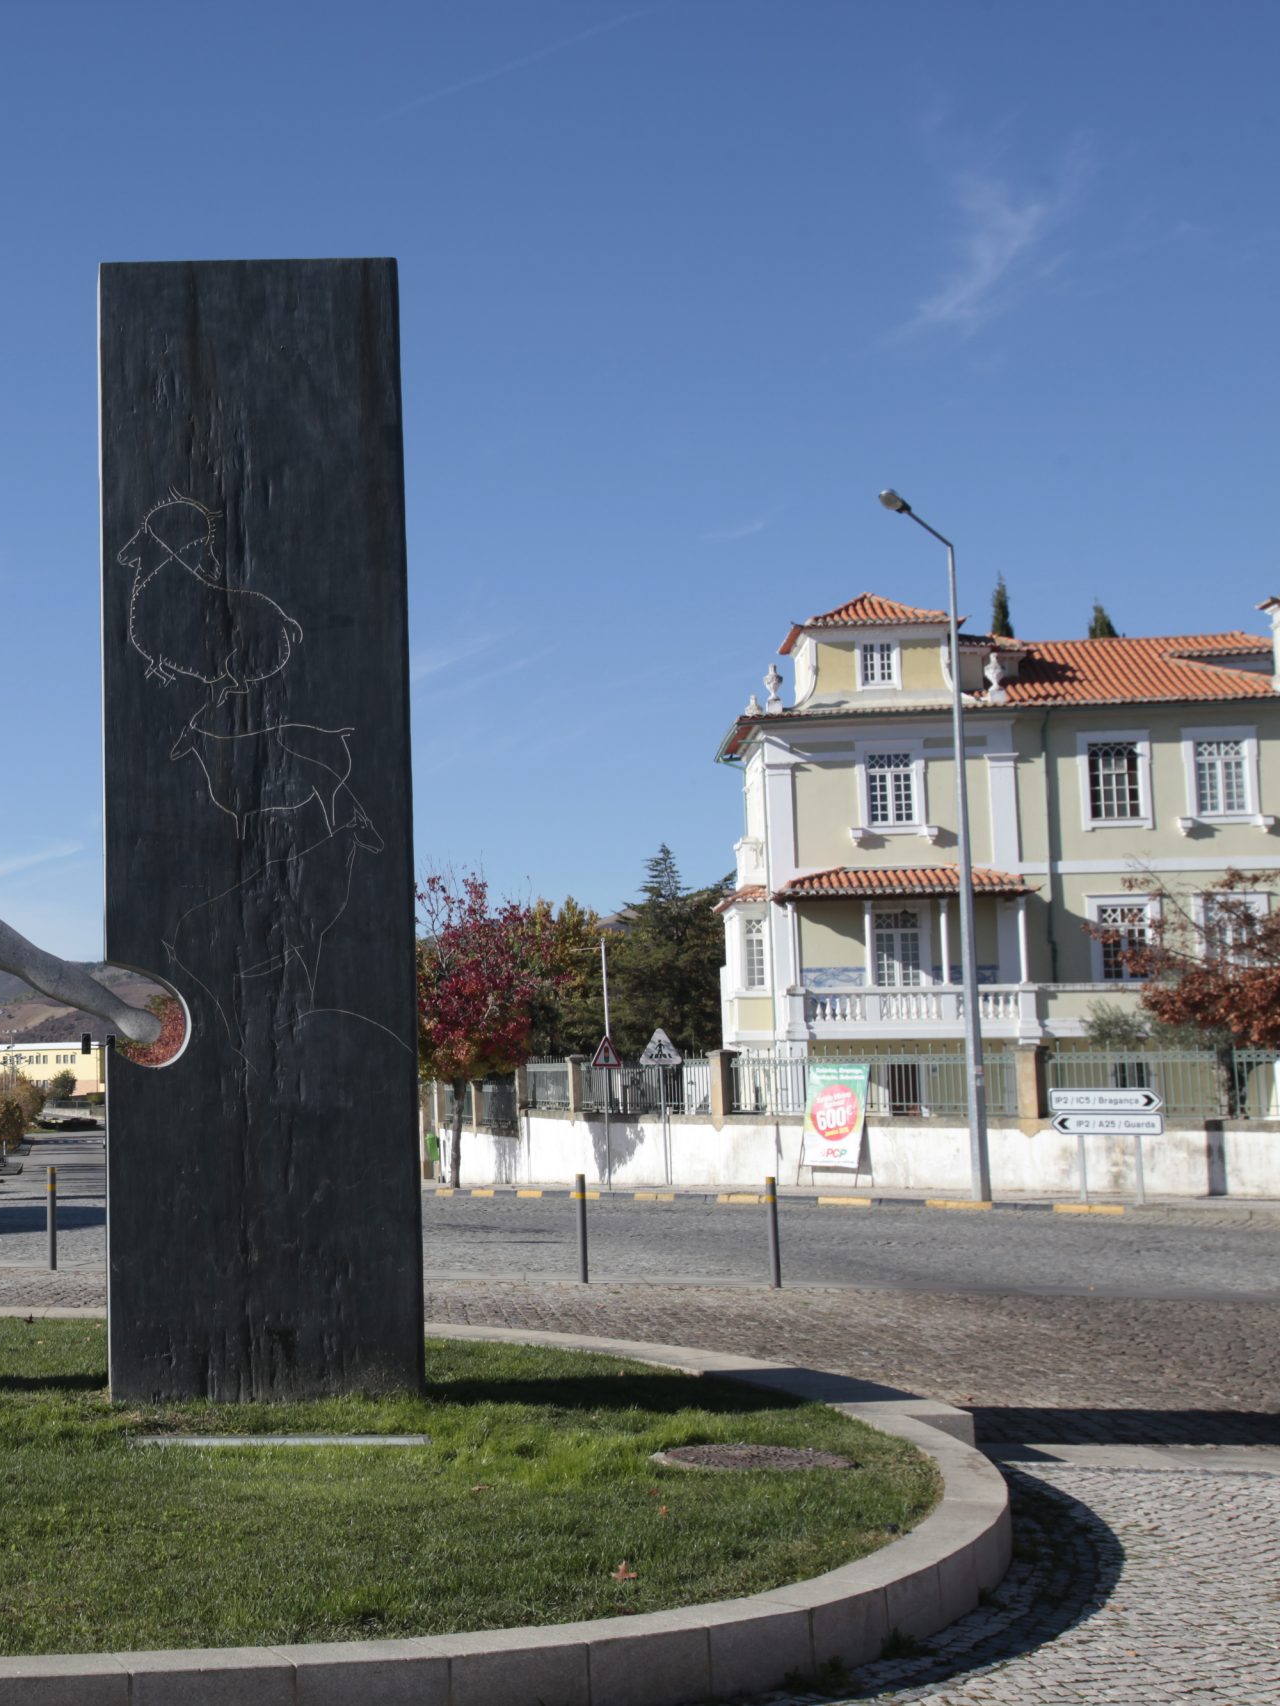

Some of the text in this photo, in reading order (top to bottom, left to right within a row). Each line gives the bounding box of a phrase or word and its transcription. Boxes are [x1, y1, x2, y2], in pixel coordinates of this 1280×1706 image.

[1055, 1096, 1068, 1104] IP2
[1076, 1096, 1090, 1104] IC5
[1098, 1096, 1139, 1106] Bragança
[1076, 1120, 1090, 1128] IP2
[1098, 1120, 1116, 1128] A25
[1124, 1120, 1155, 1128] Guarda
[826, 1148, 848, 1158] PCP
